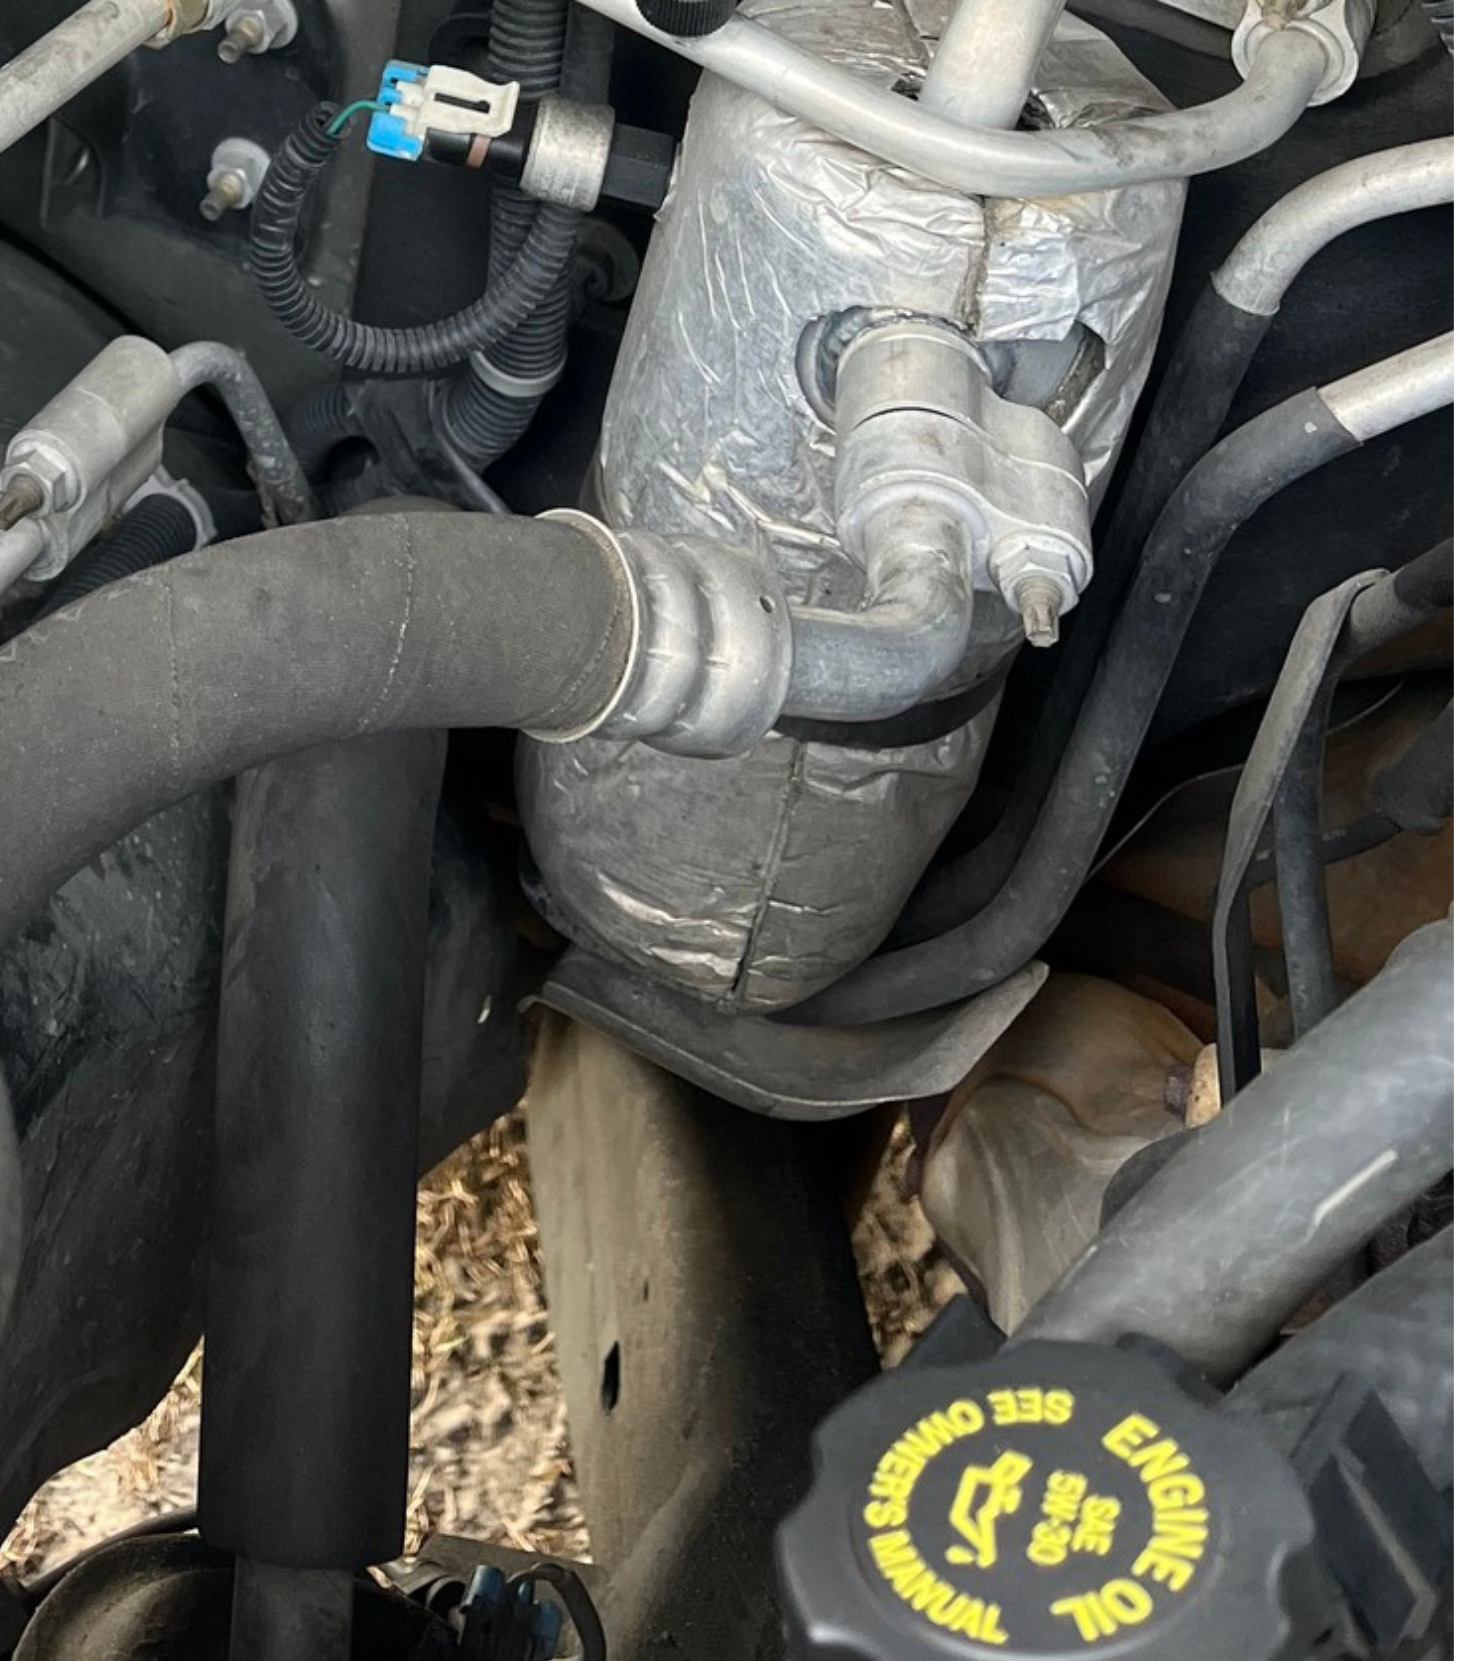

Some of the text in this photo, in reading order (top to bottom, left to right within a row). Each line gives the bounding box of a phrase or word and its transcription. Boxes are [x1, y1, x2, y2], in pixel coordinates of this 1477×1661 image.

[986, 1386, 1075, 1426] SEE
[1026, 1468, 1088, 1566] 5W-30
[1048, 1411, 1210, 1643] ENGINE OIL
[1071, 1492, 1122, 1556] SAE
[867, 1528, 1009, 1646] MANUAL
